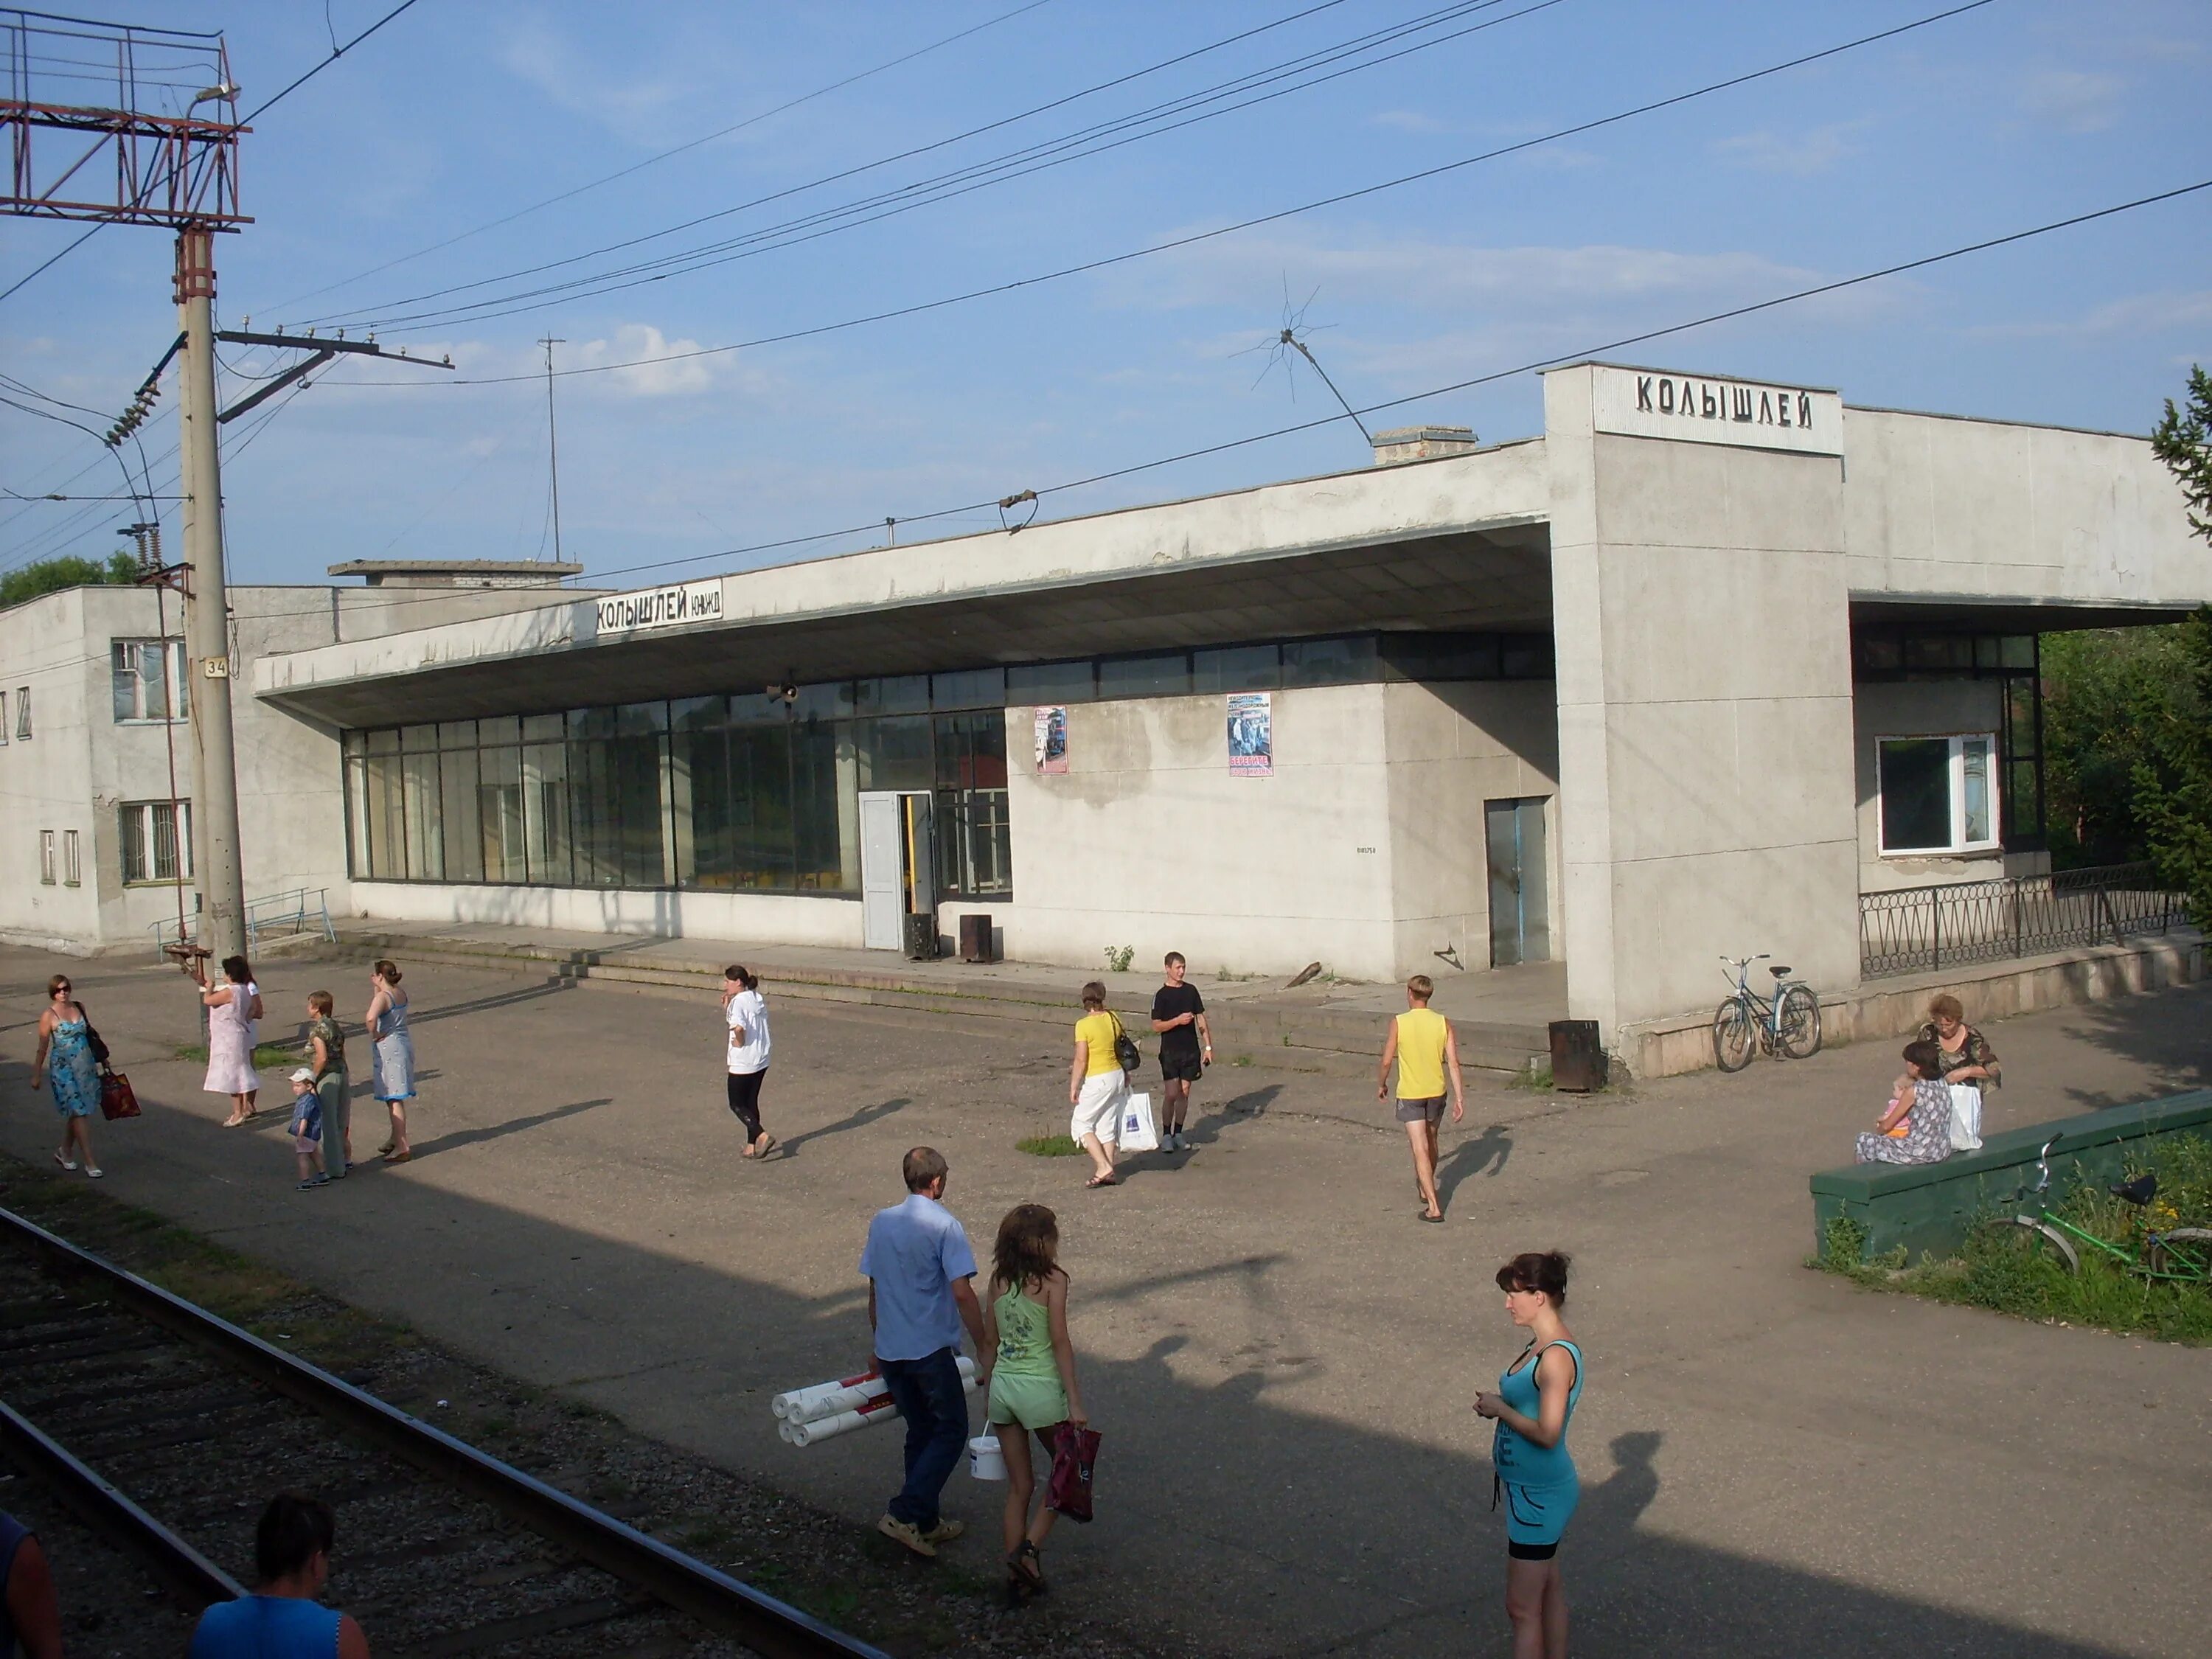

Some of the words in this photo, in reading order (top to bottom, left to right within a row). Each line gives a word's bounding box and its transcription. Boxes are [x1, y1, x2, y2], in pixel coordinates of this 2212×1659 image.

[1636, 375, 1812, 430] КОЛЫШЛЕЙ
[597, 586, 687, 629] КОЛЫШЛЕЙ
[208, 660, 225, 674] 34
[1230, 757, 1267, 765] БЕРЕГИТЕ
